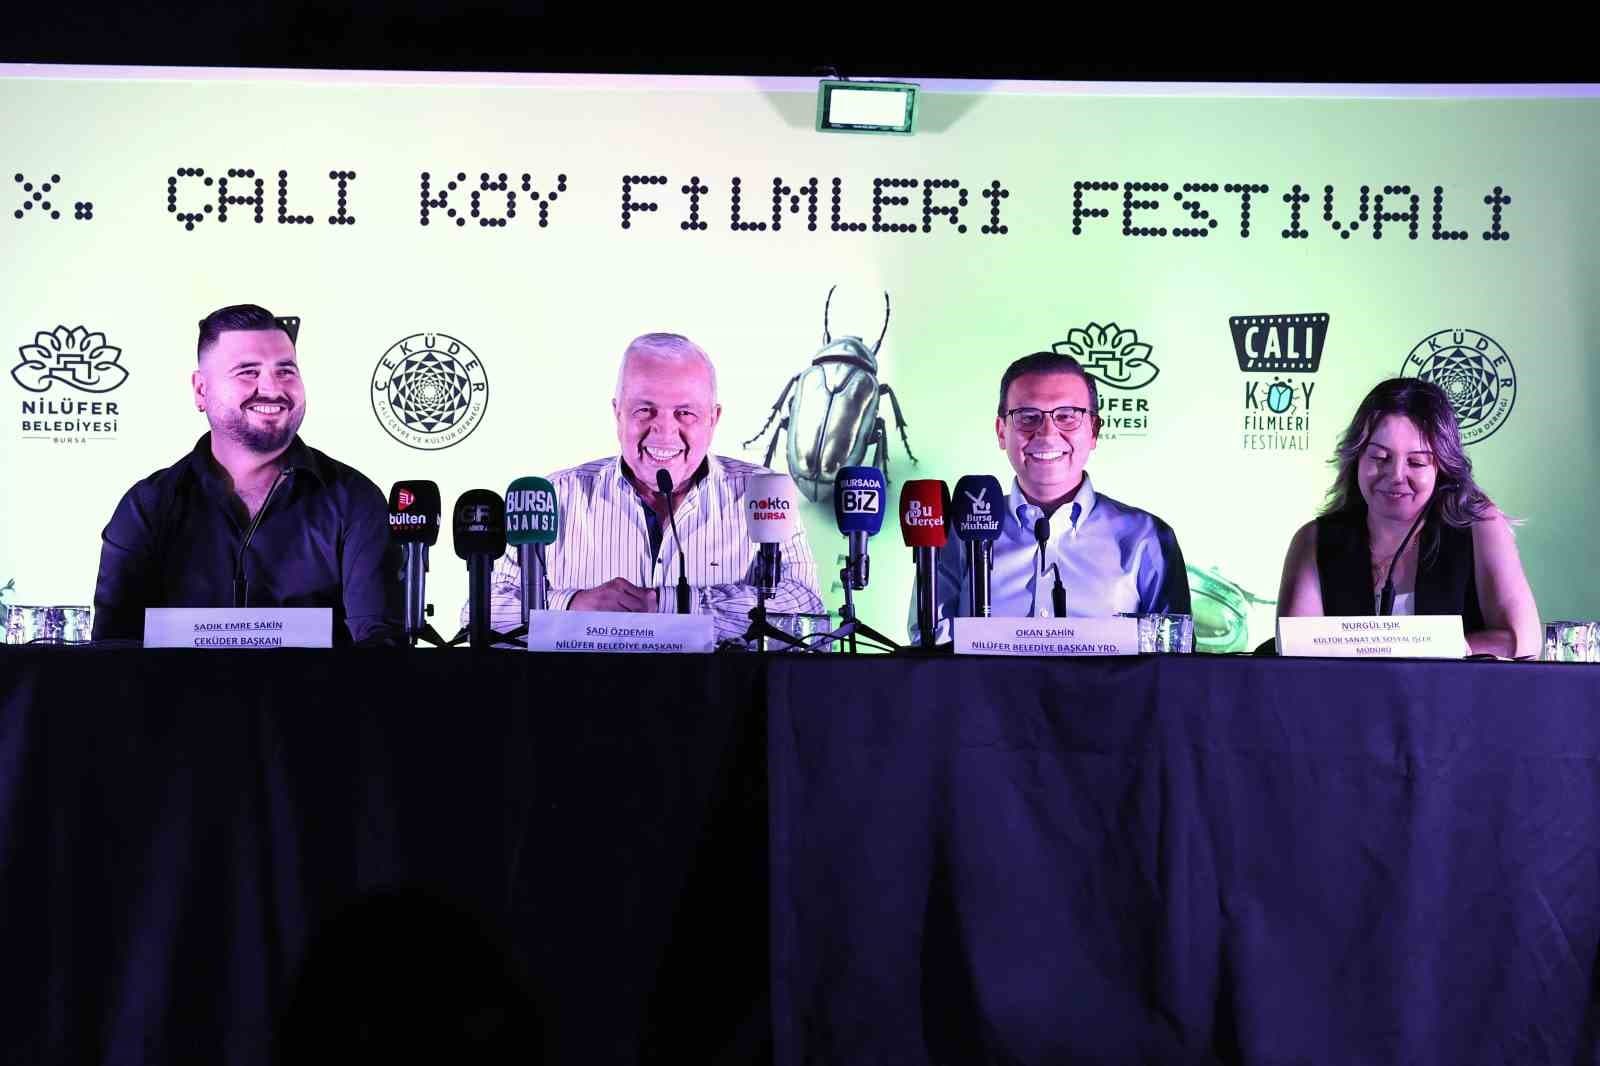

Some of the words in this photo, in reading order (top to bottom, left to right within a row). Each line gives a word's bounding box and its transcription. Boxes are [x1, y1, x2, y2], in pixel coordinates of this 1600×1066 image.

[15, 174, 92, 220] X.
[168, 168, 356, 231] ÇALI
[421, 172, 567, 227] KÖY
[1245, 326, 1313, 368] ÇALI
[375, 333, 485, 392] ÇEKÜDER
[1410, 328, 1513, 388] EKÜDER
[1245, 376, 1315, 414] KÖY
[22, 397, 119, 415] NİLÜFER
[22, 419, 117, 433] BELEDİYESİ
[1244, 411, 1309, 431] FİLMLERİ
[1243, 432, 1309, 450] FESTİVALİ
[507, 490, 555, 513] BURSA
[749, 496, 790, 510] nokta
[753, 511, 786, 521] BURSA
[909, 501, 932, 517] Bu
[389, 513, 426, 525] bülten
[966, 513, 992, 523] Bursa
[961, 520, 999, 531] Muhalif
[225, 621, 252, 630] EMRE
[610, 626, 655, 637] ÖZDEMİR
[1341, 620, 1382, 630] NURGÜL
[1016, 629, 1043, 637] OKAN
[1045, 627, 1075, 638] ŞAHİN
[194, 636, 238, 647] ÇEKÜDER
[240, 636, 282, 647] BAŞKANI
[555, 639, 595, 649] NİLÜFER
[597, 640, 641, 650] BELEDİYE
[642, 642, 683, 651] BAŞKANI
[972, 640, 1010, 650] NİLÜFER
[1012, 643, 1056, 652] BELEDİYE
[1057, 644, 1095, 653] BAŞKAN
[1097, 644, 1120, 653] YRD.
